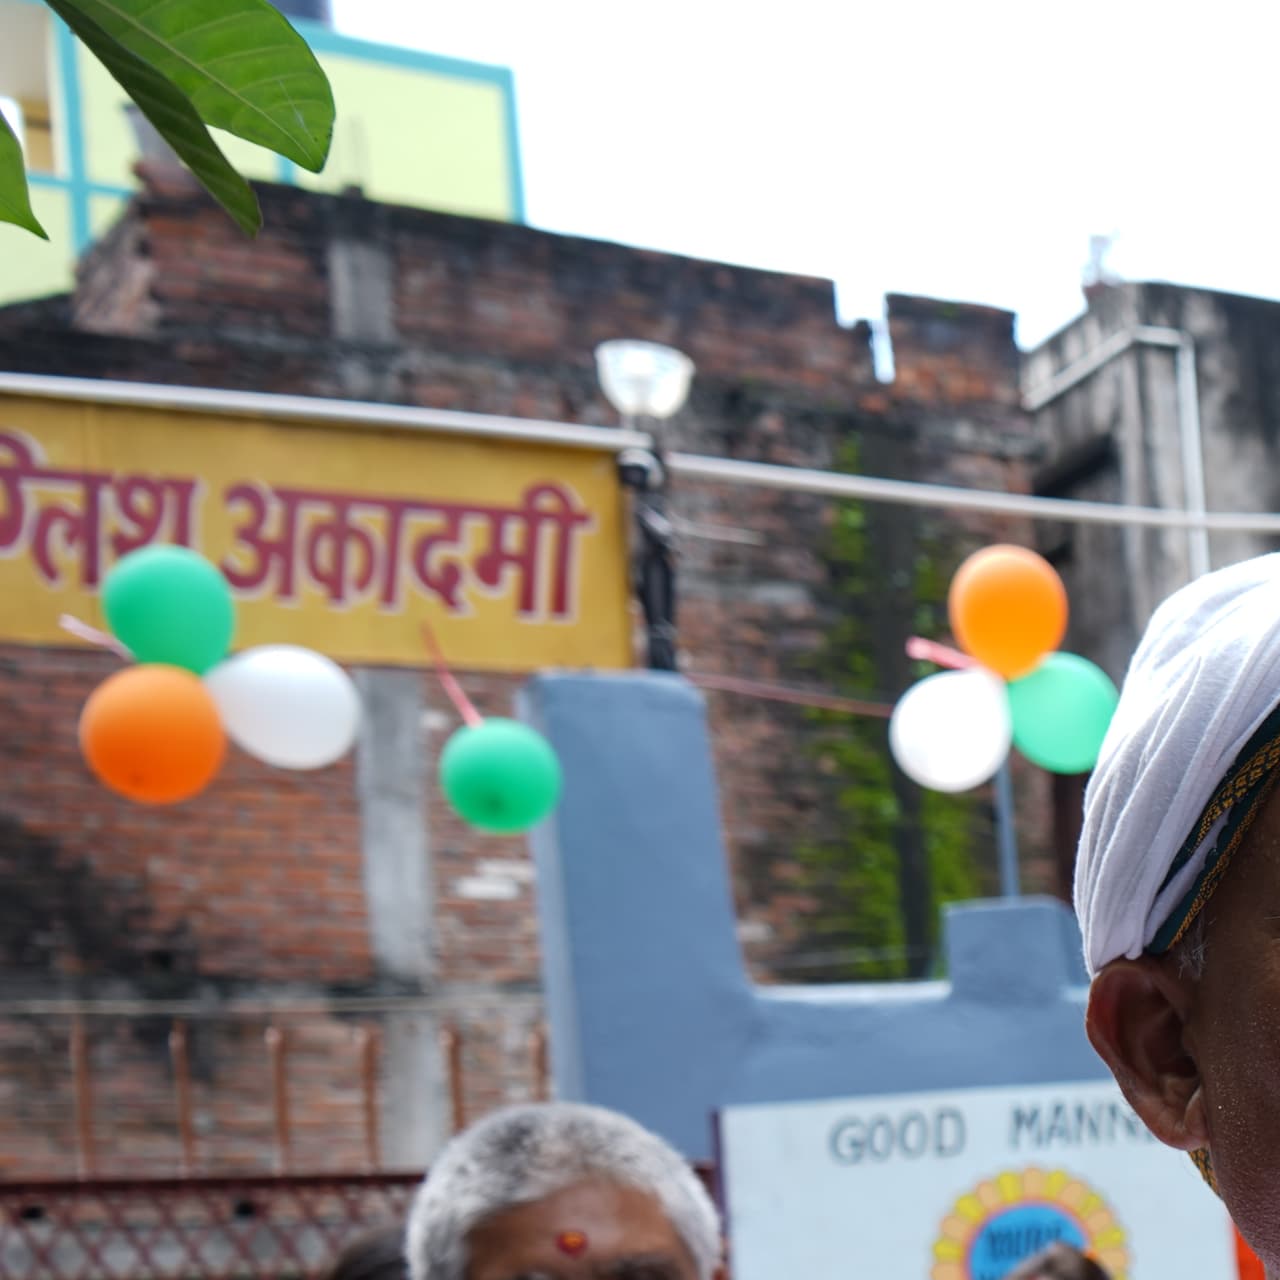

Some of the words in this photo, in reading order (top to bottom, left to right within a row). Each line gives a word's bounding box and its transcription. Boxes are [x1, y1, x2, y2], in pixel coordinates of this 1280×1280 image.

[221, 482, 590, 622] अकादमी
[829, 1106, 966, 1165] GOOD
[1009, 1101, 1155, 1150] MANN
